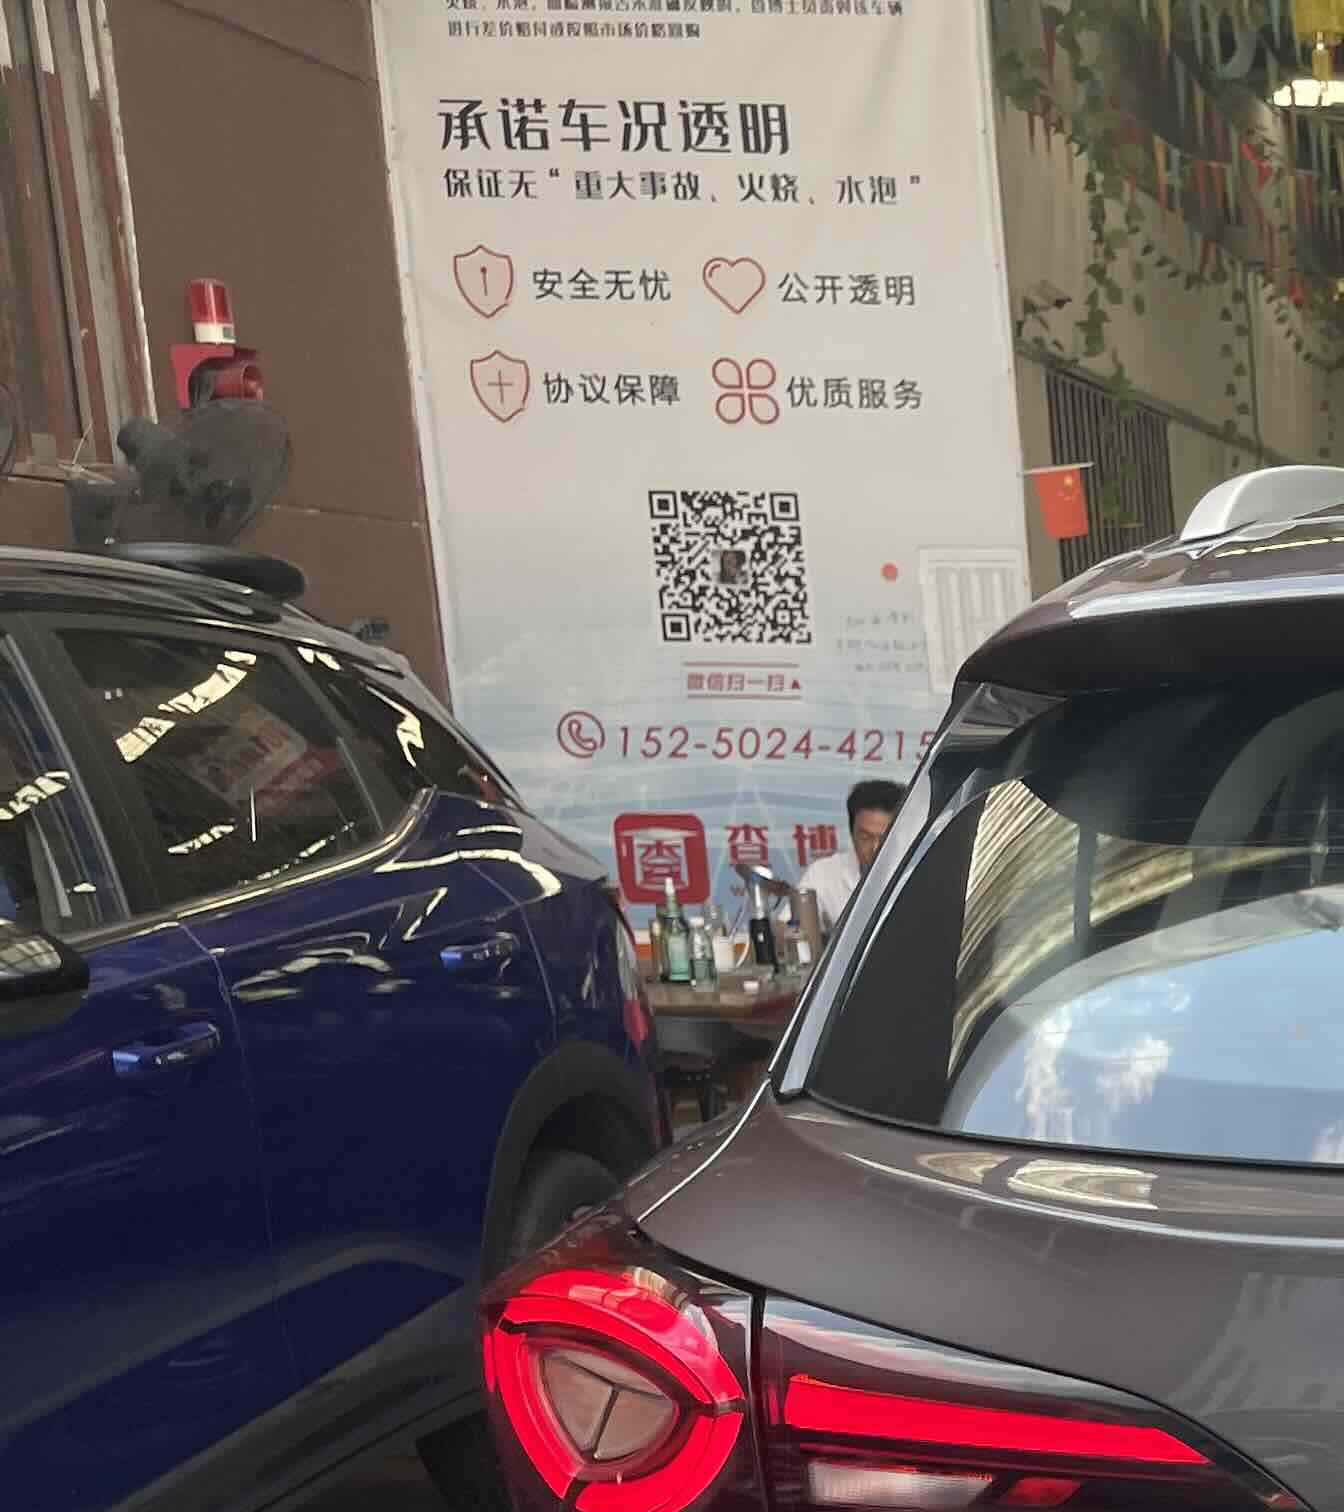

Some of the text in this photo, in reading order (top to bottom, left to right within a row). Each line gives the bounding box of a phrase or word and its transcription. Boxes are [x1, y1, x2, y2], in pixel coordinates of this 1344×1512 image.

[437, 97, 791, 156] 承诺车况透明
[532, 267, 672, 302] 安全无忧
[776, 271, 916, 307] 公开透明
[542, 371, 682, 407] 协议保障
[785, 374, 923, 411] 优质服务
[617, 724, 936, 763] 152-5024-4215
